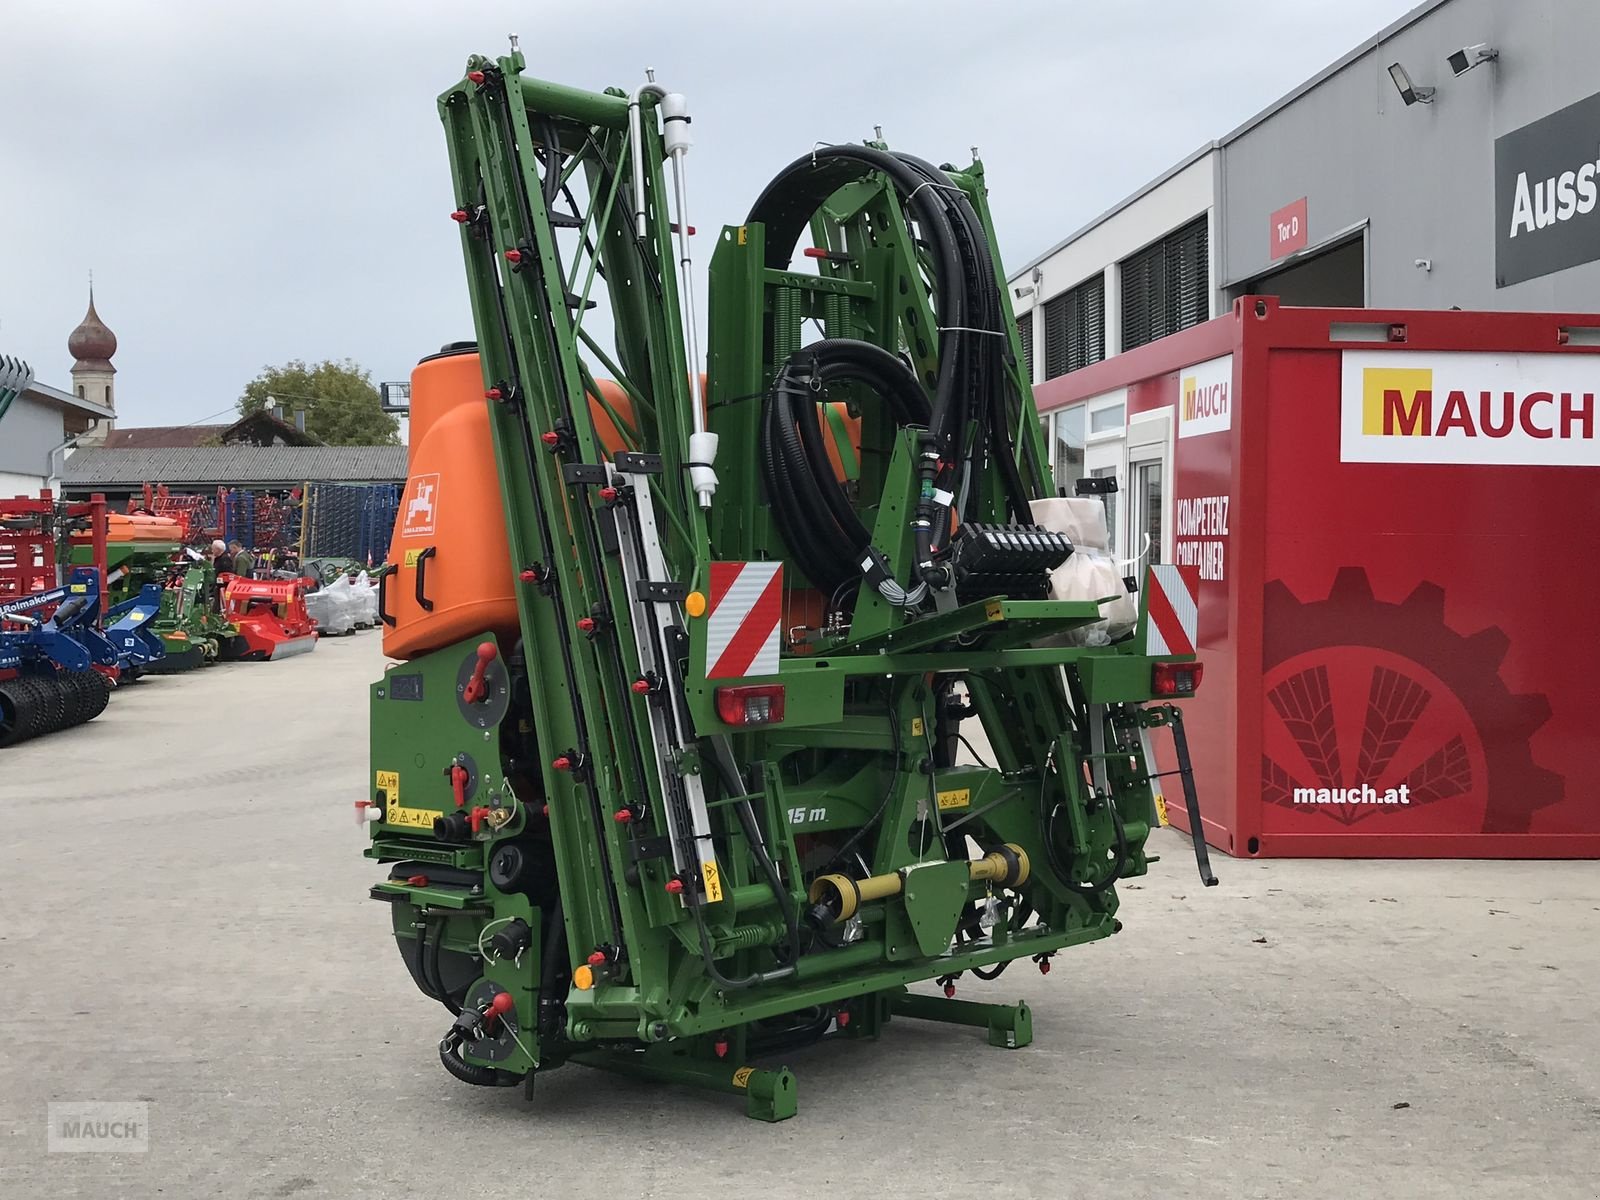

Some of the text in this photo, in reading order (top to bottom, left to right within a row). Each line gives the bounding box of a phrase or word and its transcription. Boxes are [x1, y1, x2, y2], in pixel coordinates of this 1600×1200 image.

[1277, 216, 1299, 243] Tor D
[1186, 381, 1228, 421] MAUCH
[1382, 389, 1595, 439] MAUCH
[1176, 495, 1229, 536] KOMPETENZ
[3, 595, 47, 613] Rolmako
[1293, 783, 1410, 804] mauch.at
